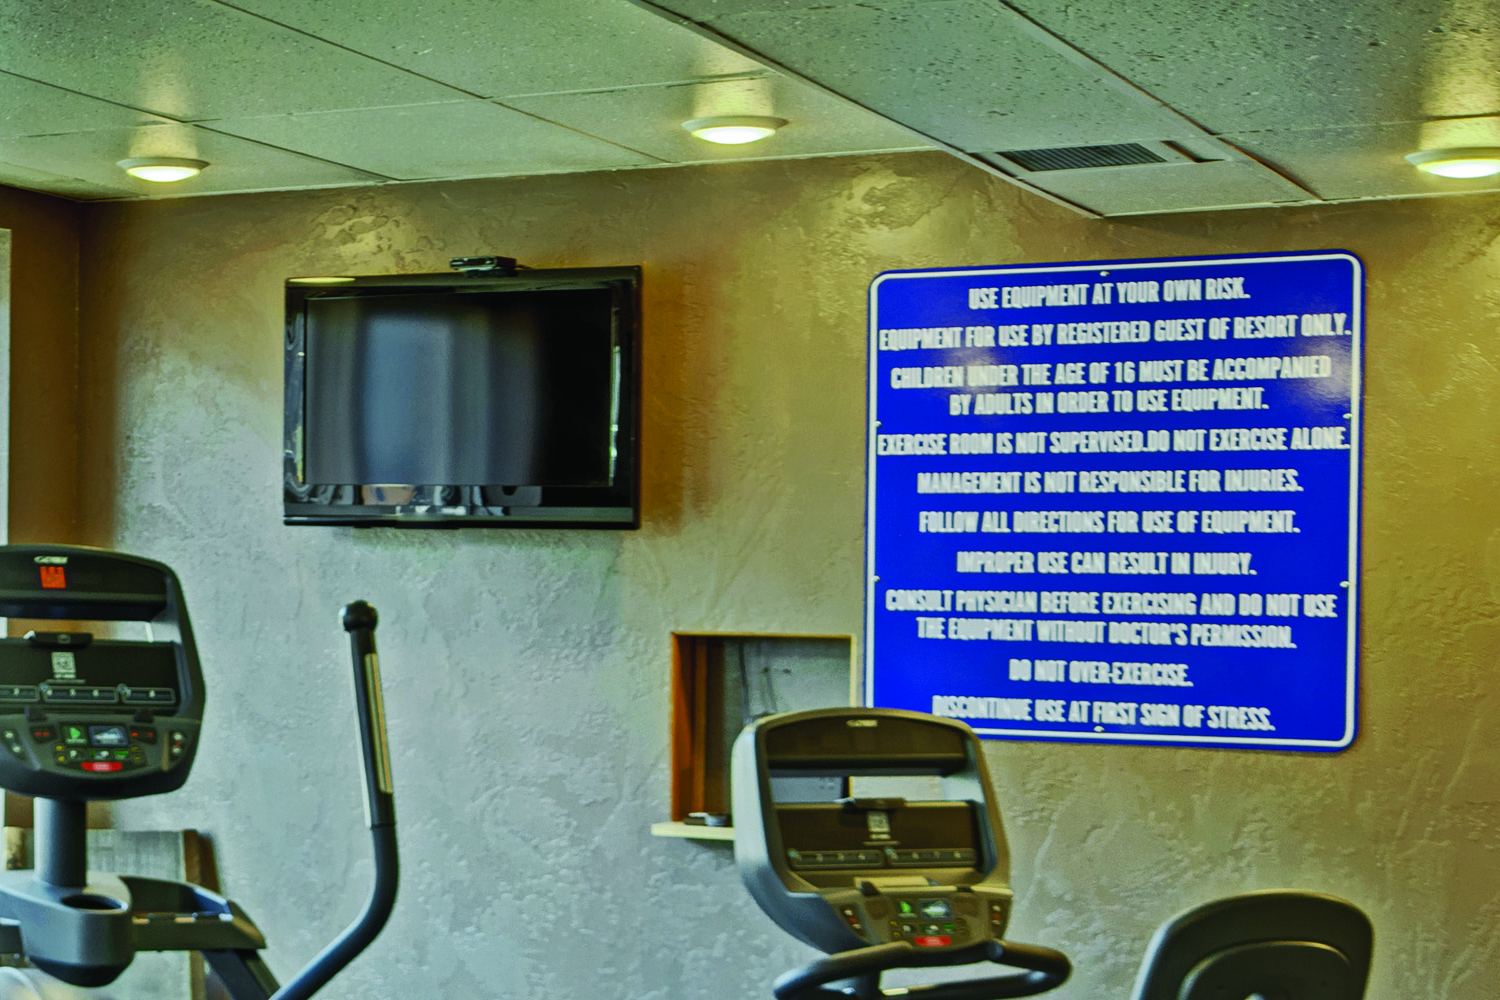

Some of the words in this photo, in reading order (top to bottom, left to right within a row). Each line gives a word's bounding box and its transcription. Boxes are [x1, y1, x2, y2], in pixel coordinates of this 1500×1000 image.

[969, 288, 998, 309] USE
[1002, 284, 1088, 308] EQUIPMENT
[1093, 283, 1112, 304] AT
[1117, 281, 1159, 303] YOUR
[1164, 279, 1201, 301] OWN
[1206, 277, 1250, 299] RISK.
[879, 327, 962, 350] EQUIPMENT
[965, 326, 995, 347] FOR
[999, 325, 1028, 346] USE
[1032, 324, 1053, 345] BY
[1057, 321, 1150, 344] REGISTERED
[1155, 319, 1205, 341] GUEST
[1209, 318, 1229, 339] OF
[1234, 315, 1297, 338] RESORT
[1301, 313, 1353, 336] ONLY.
[891, 364, 965, 388] CHILDREN
[967, 365, 1019, 387] UNDER
[1022, 364, 1051, 385] THE
[1055, 363, 1085, 384] AGE
[1090, 362, 1109, 383] OF
[1116, 361, 1135, 382] 16
[1140, 360, 1183, 382] MUST
[1188, 359, 1208, 381] BE
[1213, 355, 1332, 381] ACCOMPANIED
[950, 390, 972, 415] BY
[974, 389, 1032, 414] ADULTS
[1036, 393, 1053, 413] IN
[1058, 391, 1108, 413] ORDER
[1113, 391, 1132, 412] TO
[1137, 390, 1168, 411] USE
[1172, 387, 1268, 411] EQUIPMENT.
[878, 434, 947, 455] EXERCISE
[950, 433, 993, 454] ROOM
[997, 433, 1012, 453] IS
[1016, 432, 1046, 453] NOT
[1174, 429, 1206, 451] NOT
[1210, 428, 1287, 450] EXERCISE
[1291, 427, 1351, 449] ALONE.
[918, 472, 1020, 493] MANAGEMENT
[1025, 472, 1041, 493] IS
[1045, 471, 1076, 492] NOT
[1080, 470, 1185, 492] RESPONSIBLE
[1189, 470, 1220, 492] FOR
[1225, 469, 1303, 491] INJURIES.
[920, 511, 978, 532] FOLLOW
[982, 512, 1010, 532] ALL
[1014, 511, 1104, 532] DIRECTIONS
[1108, 511, 1138, 532] FOR
[1143, 511, 1174, 532] USE
[1177, 511, 1198, 532] OF
[1202, 510, 1300, 533] EQUIPMENT.
[957, 552, 1034, 573] IMPROPER
[1038, 552, 1068, 573] USE
[1072, 552, 1105, 573] CAN
[1109, 552, 1167, 574] RESULT
[1172, 553, 1190, 574] IN
[1194, 553, 1256, 574] INJURY.
[886, 590, 952, 611] CONSULT
[956, 591, 1037, 612] PHYSICIAN
[1041, 592, 1099, 613] BEFORE
[1103, 592, 1196, 614] EXERCISING
[1200, 594, 1235, 615] AND
[1239, 594, 1262, 616] DO
[1267, 594, 1300, 616] NOT
[1304, 594, 1337, 617] USE
[916, 617, 945, 639] THE
[949, 618, 1033, 640] EQUIPMENT
[1037, 620, 1104, 642] WITHOUT
[1109, 622, 1187, 645] DOCTOR'S
[1191, 624, 1296, 648] PERMISSION.
[1010, 659, 1031, 680] DO
[1035, 660, 1065, 681] NOT
[1070, 661, 1193, 686] OVER-EXERCISE.
[932, 695, 1032, 720] DISCONTINUE
[1035, 700, 1065, 721] USE
[1069, 701, 1089, 722] AT
[1092, 701, 1138, 724] FIRST
[1140, 704, 1179, 726] SIGN
[1183, 705, 1204, 727] OF
[1208, 706, 1275, 730] STRESS.
